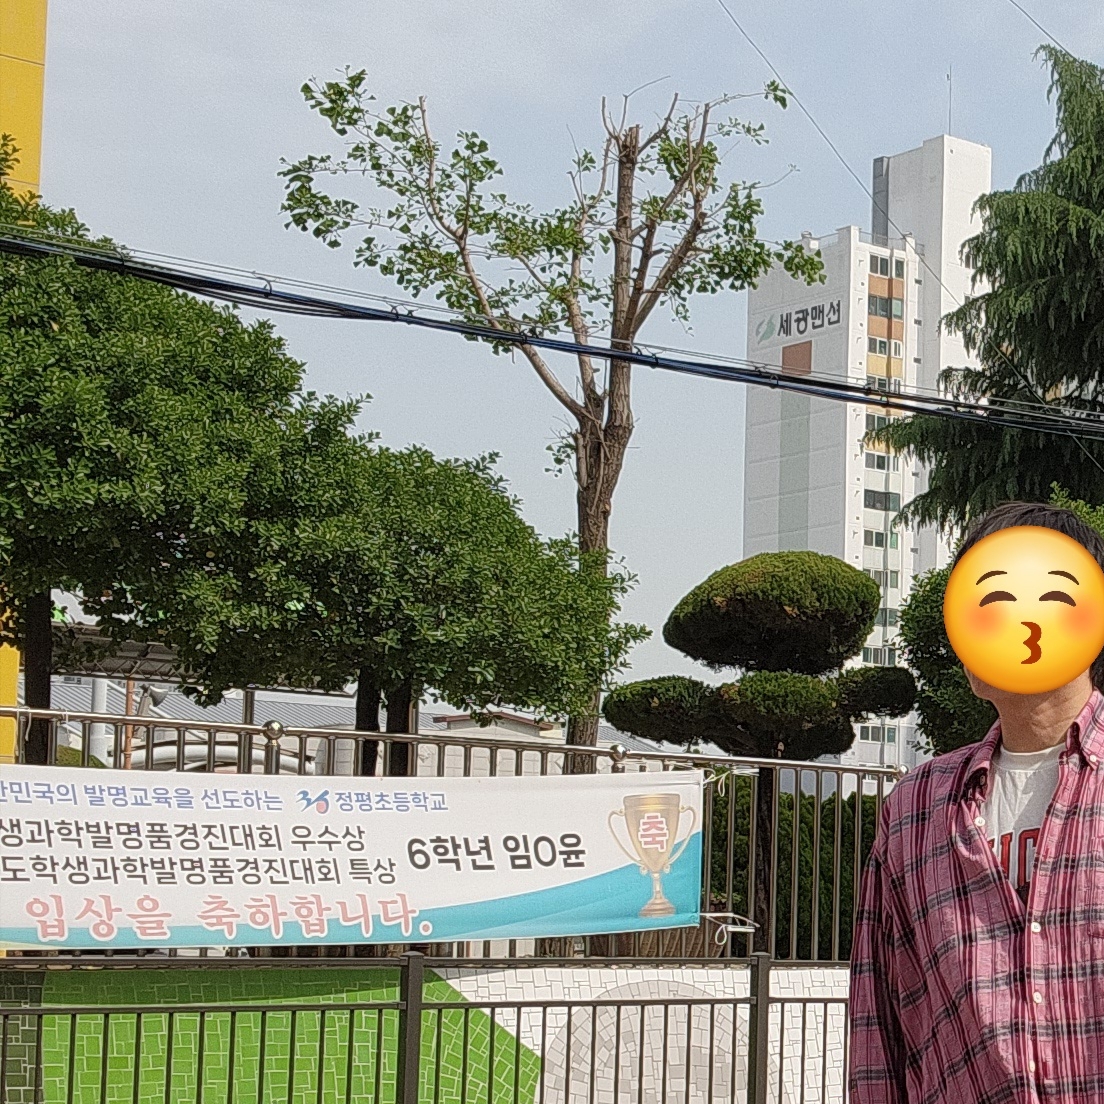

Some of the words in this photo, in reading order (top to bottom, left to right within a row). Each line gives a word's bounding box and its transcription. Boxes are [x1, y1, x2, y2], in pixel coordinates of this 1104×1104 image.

[777, 300, 841, 337] 세광맨션
[84, 784, 195, 810] 발명교육을
[201, 788, 284, 812] 선도하는
[334, 791, 449, 813] 정평초등학교
[291, 824, 366, 851] 우수상
[640, 813, 671, 853] 축
[1, 854, 341, 885] 도학생과학발명품경진대회
[348, 857, 397, 885] 특상
[407, 834, 496, 872] 6학년
[26, 894, 172, 939] 입상을
[197, 892, 430, 938] 축하합니다.
